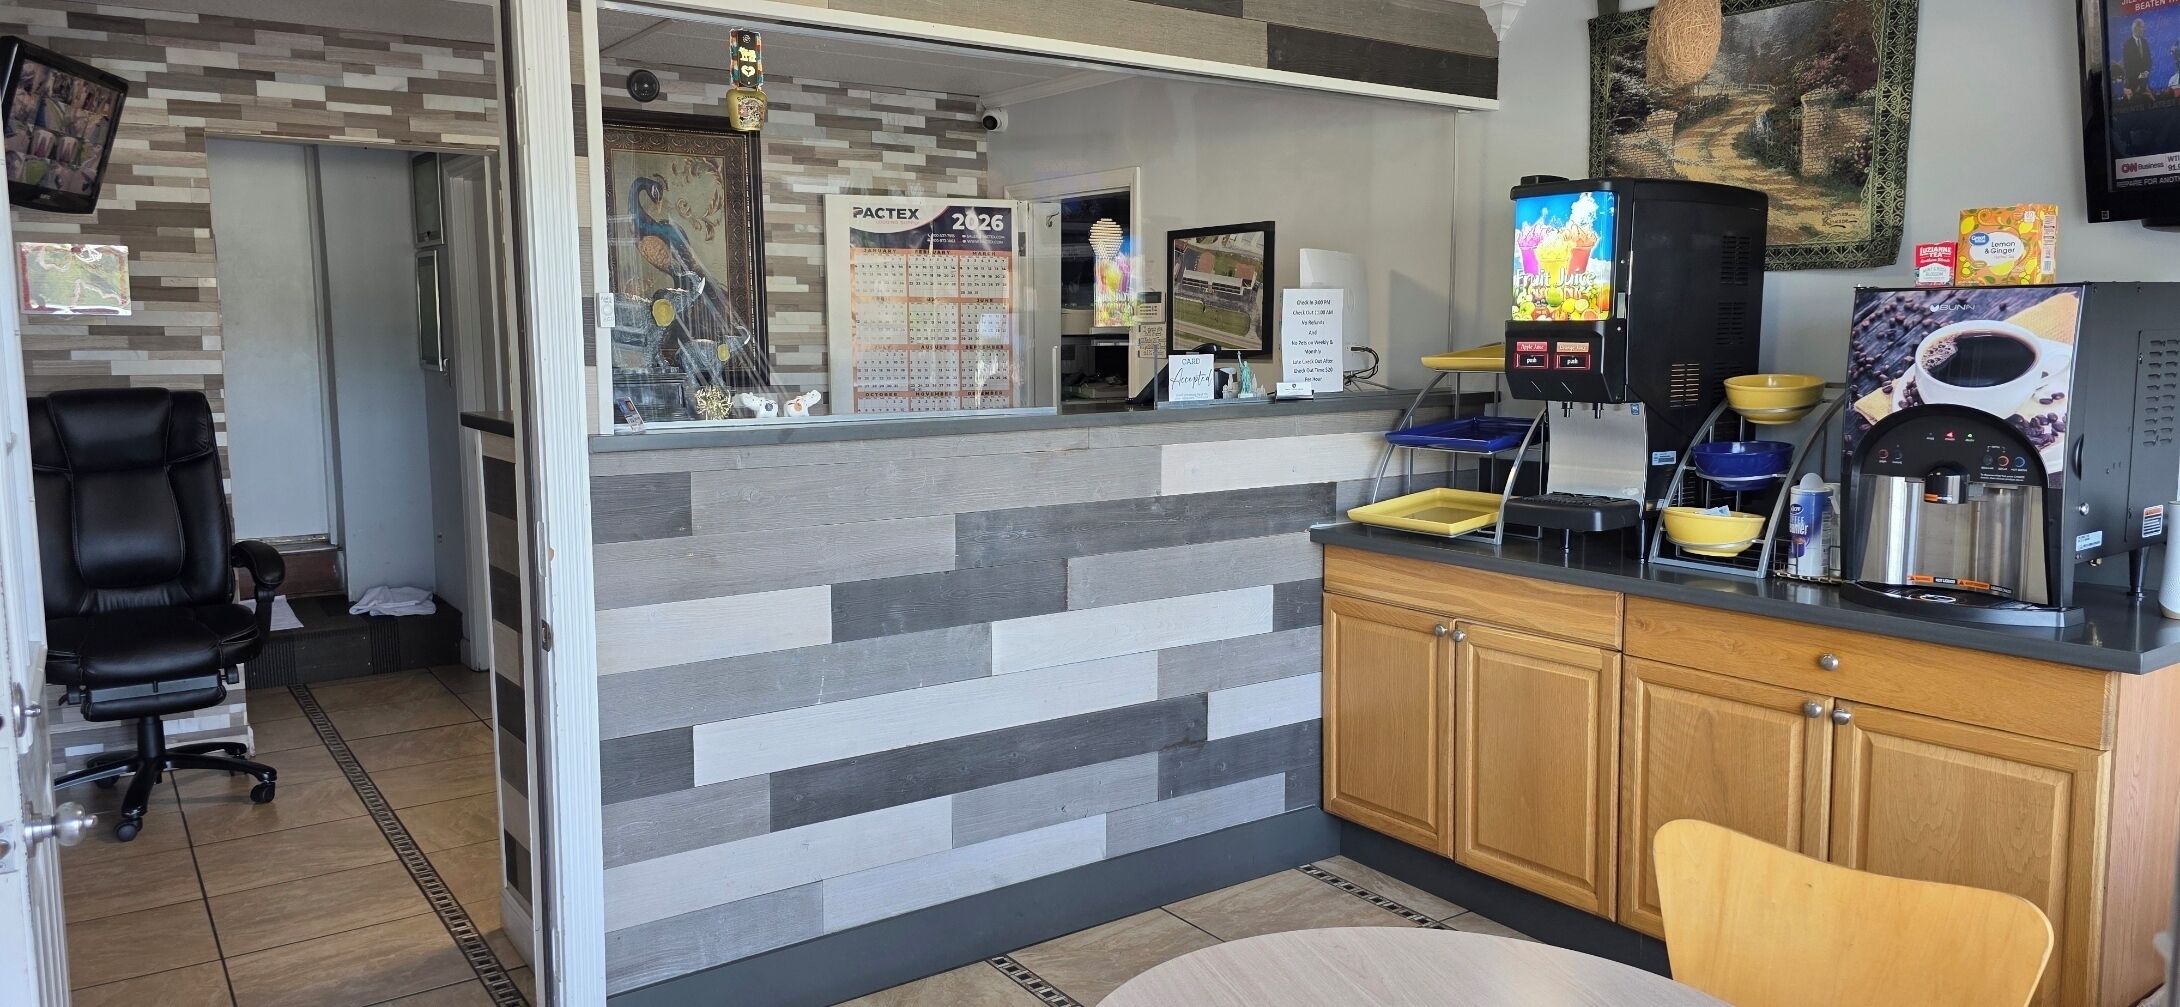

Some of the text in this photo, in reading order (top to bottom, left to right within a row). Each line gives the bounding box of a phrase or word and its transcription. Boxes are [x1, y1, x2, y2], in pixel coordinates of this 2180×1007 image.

[2122, 162, 2138, 174] CNN
[852, 206, 920, 220] PACTEX
[951, 213, 1004, 231] 2026
[1920, 246, 1952, 256] LUZIANNE
[1516, 268, 1596, 287] Fruit Juice
[1170, 368, 1212, 390] Accepted
